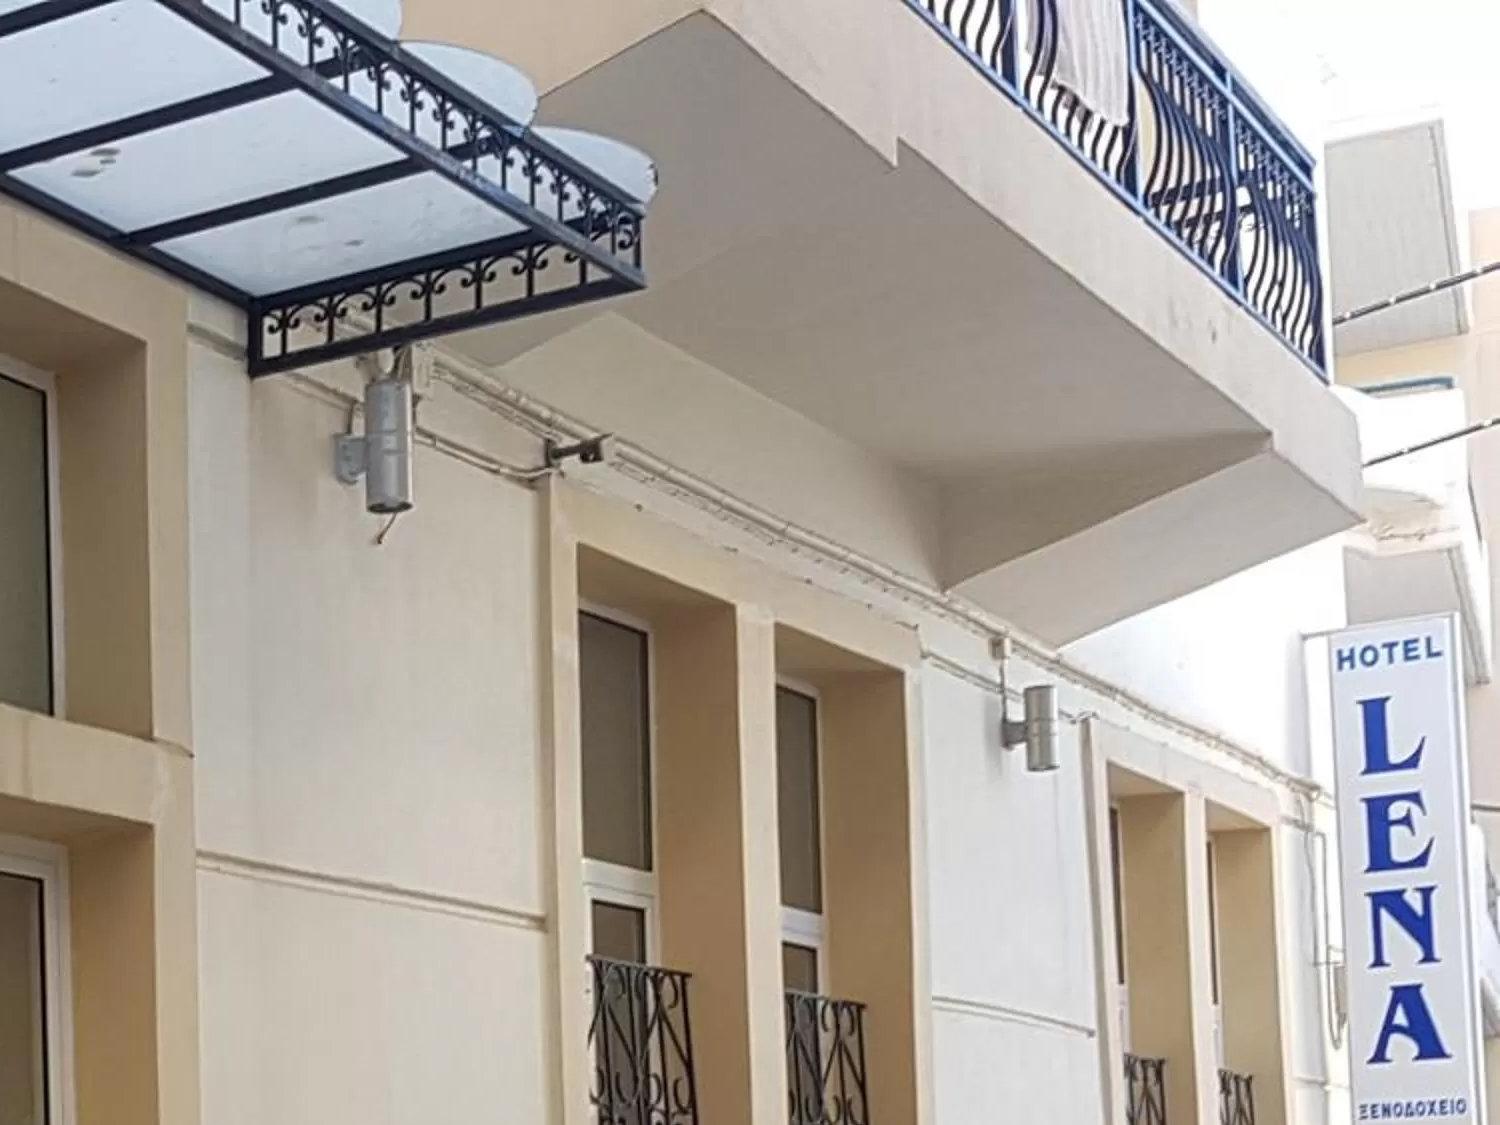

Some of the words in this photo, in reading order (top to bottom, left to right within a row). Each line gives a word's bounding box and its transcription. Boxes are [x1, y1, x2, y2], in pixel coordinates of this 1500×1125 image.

[1336, 635, 1444, 672] HOTEL
[1356, 695, 1453, 1065] LENA
[1358, 1097, 1468, 1121] ΞΕΝΟΔΟΧΕΙΟ
